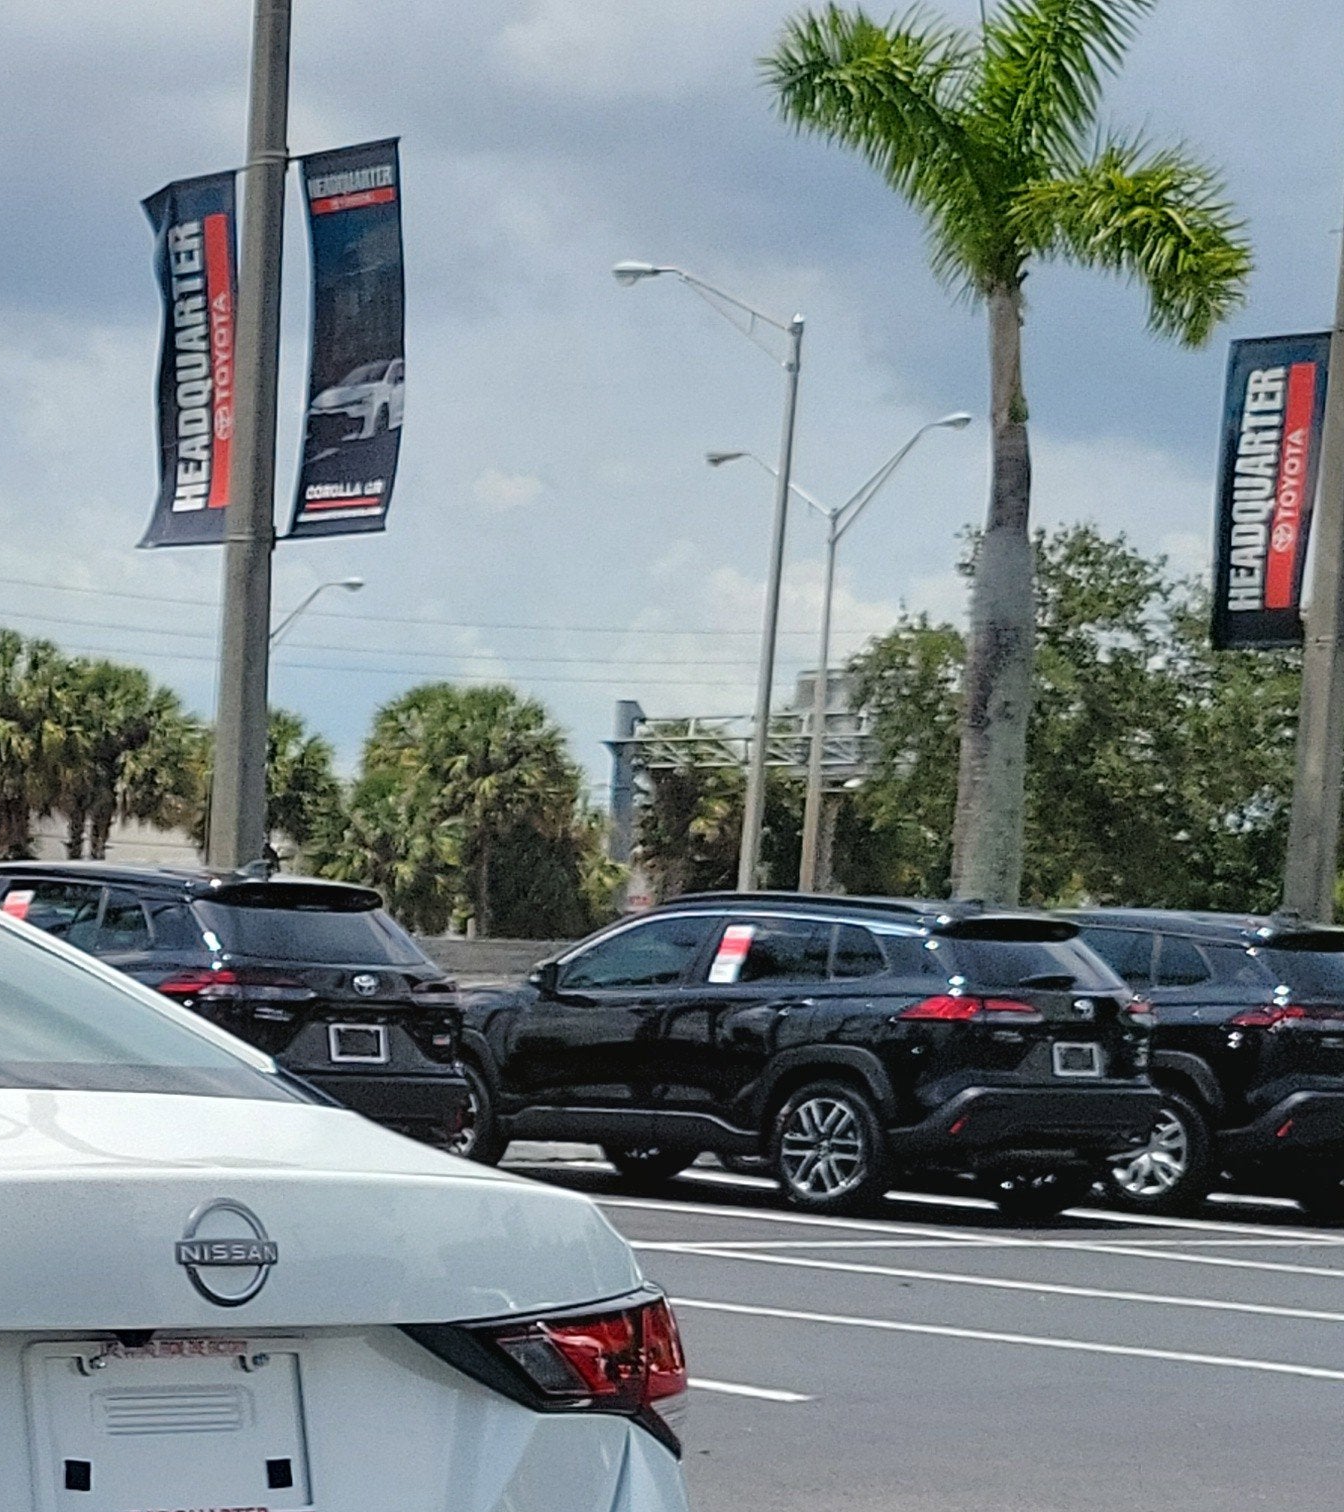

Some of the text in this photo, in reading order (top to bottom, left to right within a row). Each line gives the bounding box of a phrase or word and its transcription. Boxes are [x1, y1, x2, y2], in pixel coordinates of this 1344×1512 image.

[167, 220, 213, 512] HEADQUARTER
[212, 290, 233, 400] TOYOTA
[1228, 365, 1286, 612] HEADQUARTER
[1277, 427, 1307, 519] TOYOTA
[180, 1243, 277, 1262] NISSAN
